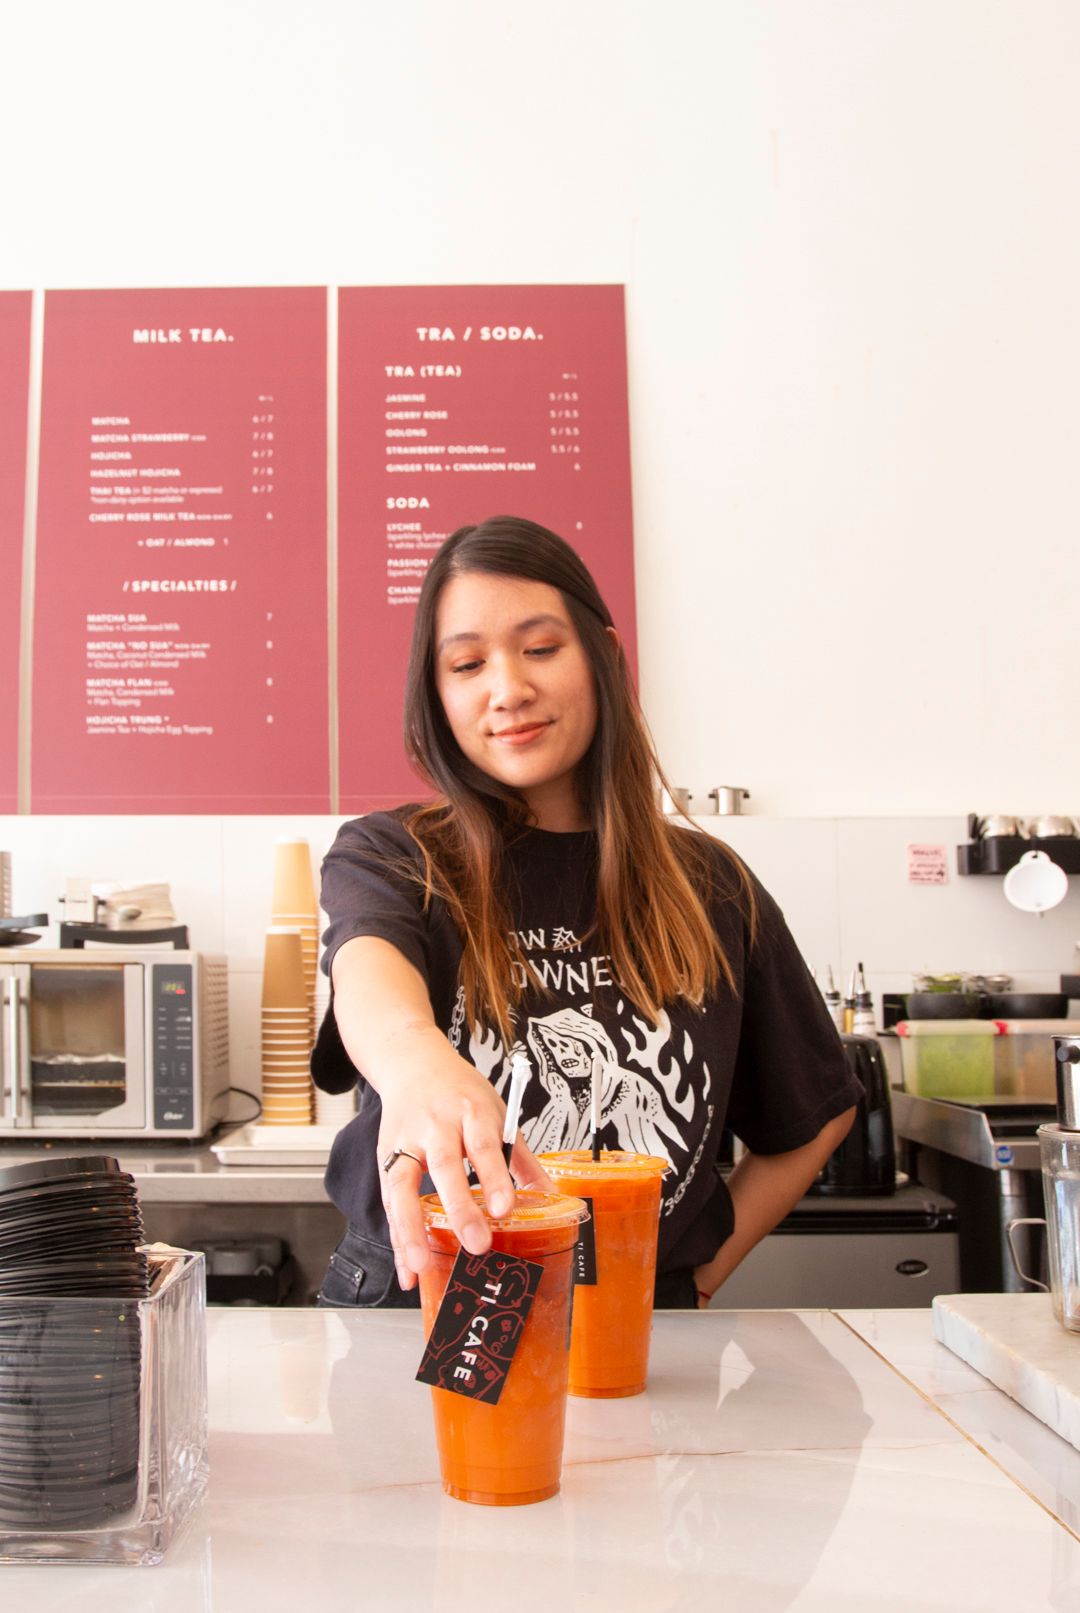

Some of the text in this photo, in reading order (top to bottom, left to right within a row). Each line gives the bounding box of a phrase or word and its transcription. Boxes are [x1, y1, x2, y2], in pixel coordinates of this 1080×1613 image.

[133, 328, 234, 343] MILK TEA.
[417, 327, 455, 341] TRA
[480, 326, 544, 341] SODA.
[385, 365, 462, 378] TRA (TEA)
[385, 394, 426, 403] JASMINE
[385, 411, 421, 420] CHERRY
[423, 411, 448, 419] ROSE
[91, 416, 130, 426] MATCHA
[385, 428, 427, 437] OOLONG
[91, 434, 130, 443] MATCHA
[131, 433, 190, 443] STRAWBERRY
[386, 446, 445, 455] STRAWBERRY
[448, 445, 489, 454] OOLONG
[386, 464, 422, 472] GINGER
[424, 463, 442, 472] TEA
[453, 463, 506, 471] CINNAMON
[508, 462, 536, 471] FOAM
[90, 486, 112, 495] THAI
[114, 486, 131, 495] TEA
[387, 497, 430, 509] SODA
[89, 513, 124, 522] CHERRY
[127, 513, 150, 522] ROSE
[153, 513, 175, 521] MILK
[178, 512, 195, 521] TEA
[387, 523, 421, 532] LYCHEE
[146, 538, 165, 547] OAT
[174, 538, 215, 547] ALMOND
[387, 559, 428, 568] PASSION
[132, 580, 228, 593] SPECIALTIES
[87, 614, 126, 623] MATCHA
[87, 642, 125, 650] MATCHA
[86, 679, 125, 687] MATCHA
[128, 678, 152, 687] FLAN
[86, 716, 128, 725] HOJICHA
[578, 1242, 583, 1250] TI
[453, 1282, 502, 1381] TI CAFE
